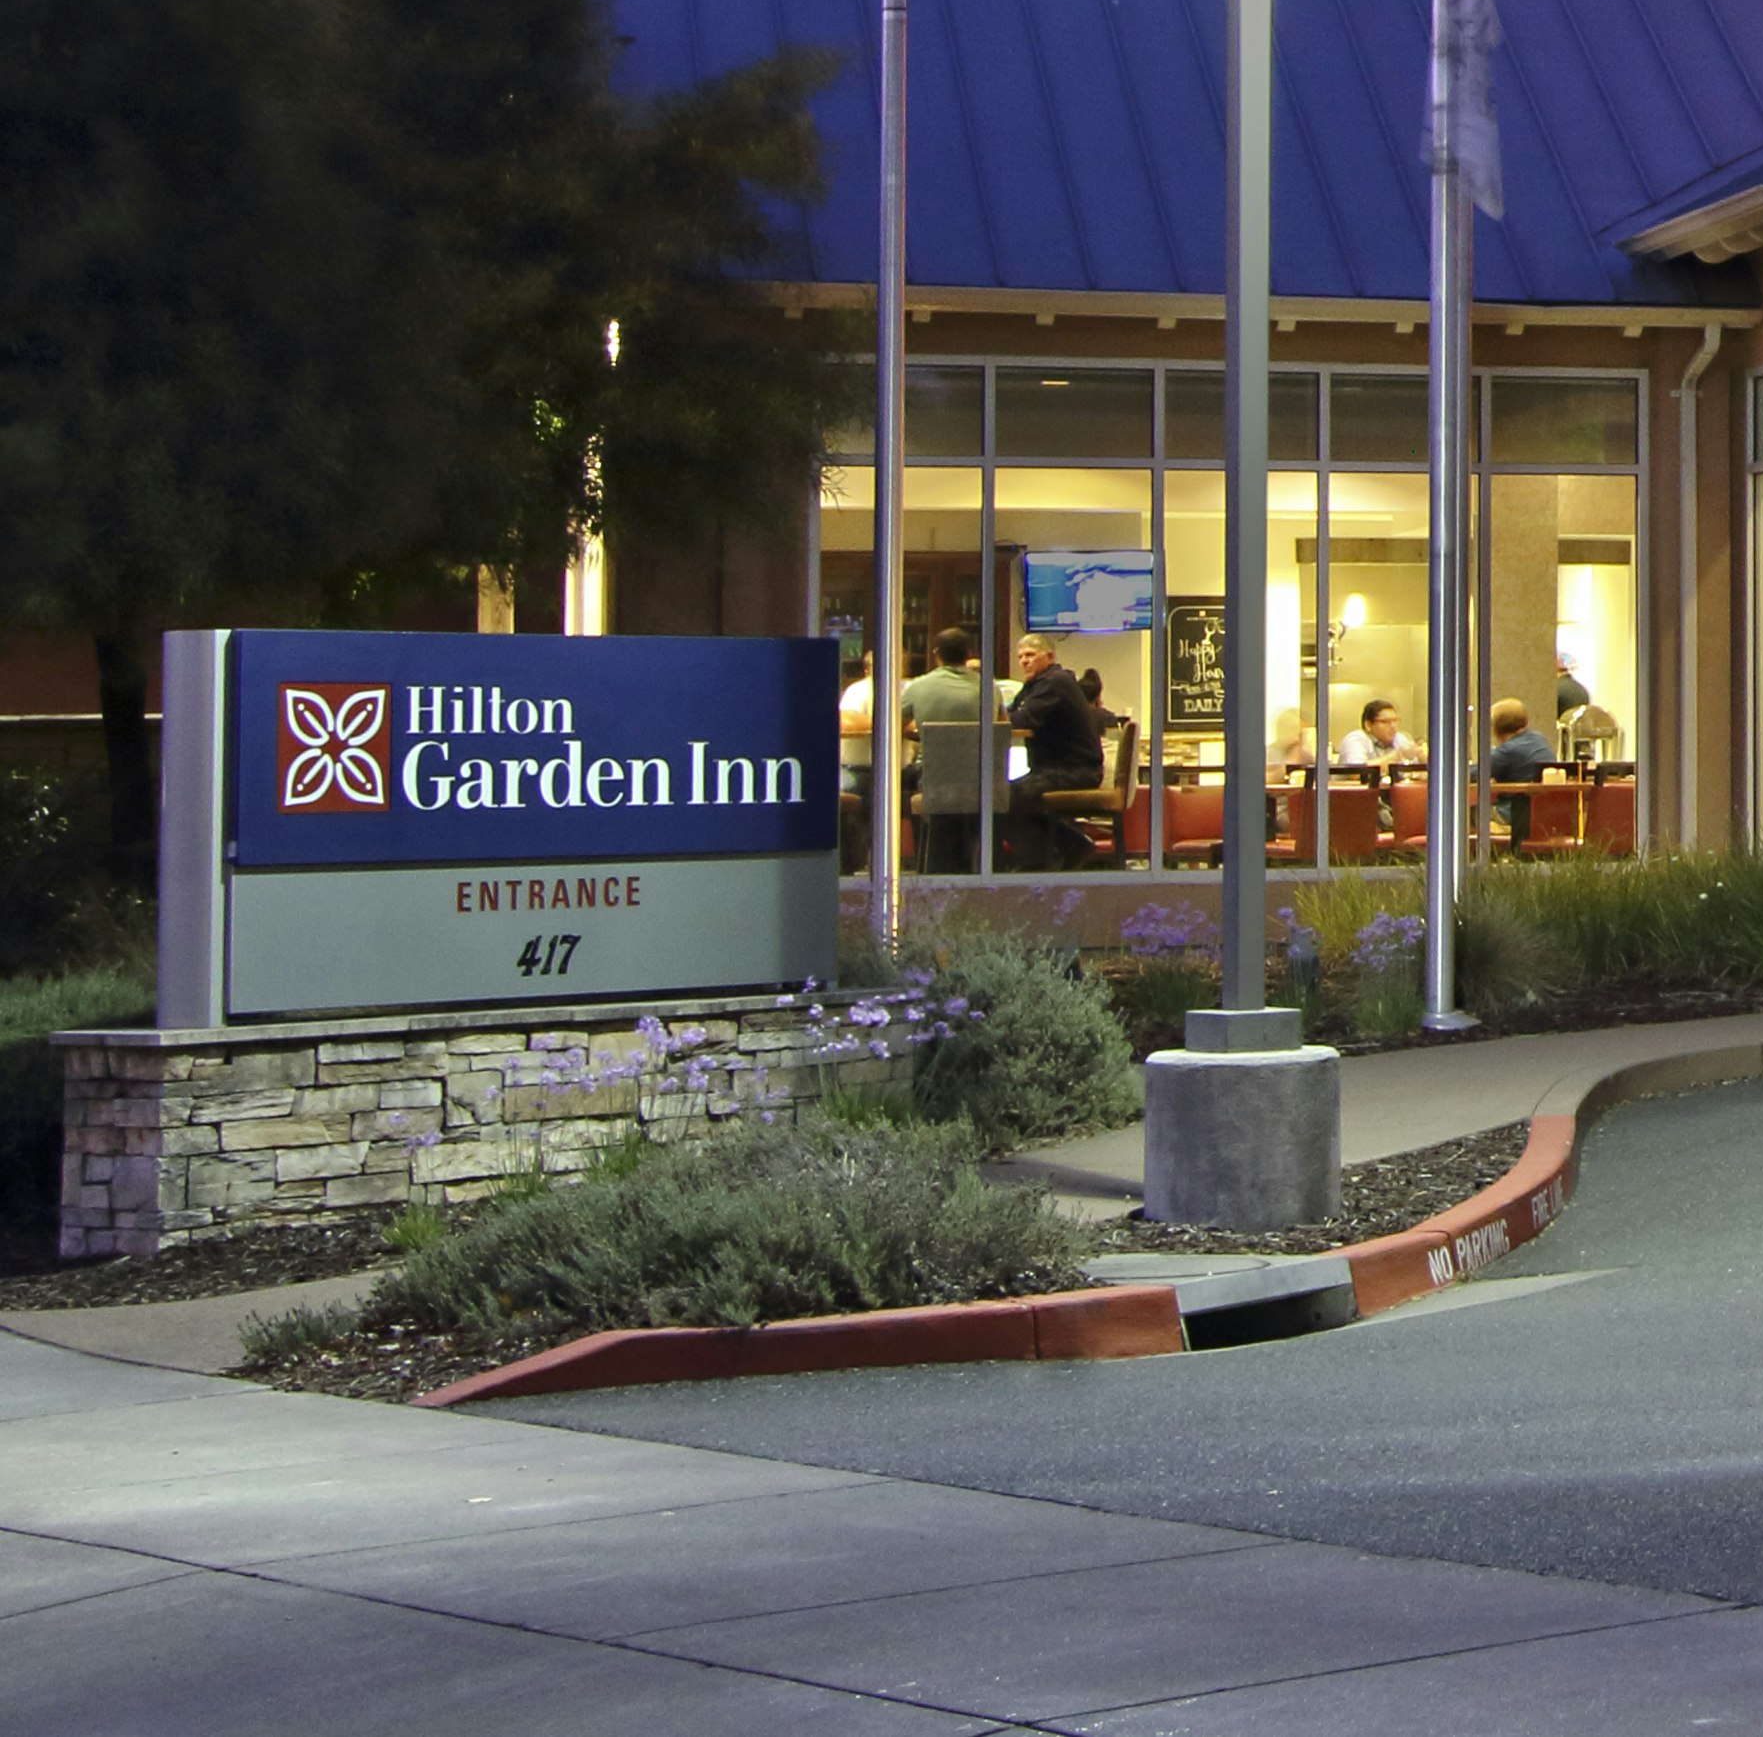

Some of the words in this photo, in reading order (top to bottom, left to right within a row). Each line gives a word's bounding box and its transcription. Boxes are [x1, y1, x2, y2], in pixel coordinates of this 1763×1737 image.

[406, 685, 575, 735] Hilton
[1183, 697, 1224, 712] DAILY
[402, 740, 673, 810] Garden
[686, 741, 805, 805] Inn
[456, 876, 641, 913] ENTRANCE
[516, 934, 581, 977] 417
[1427, 1245, 1454, 1286] NO
[1455, 1219, 1511, 1272] PARKING
